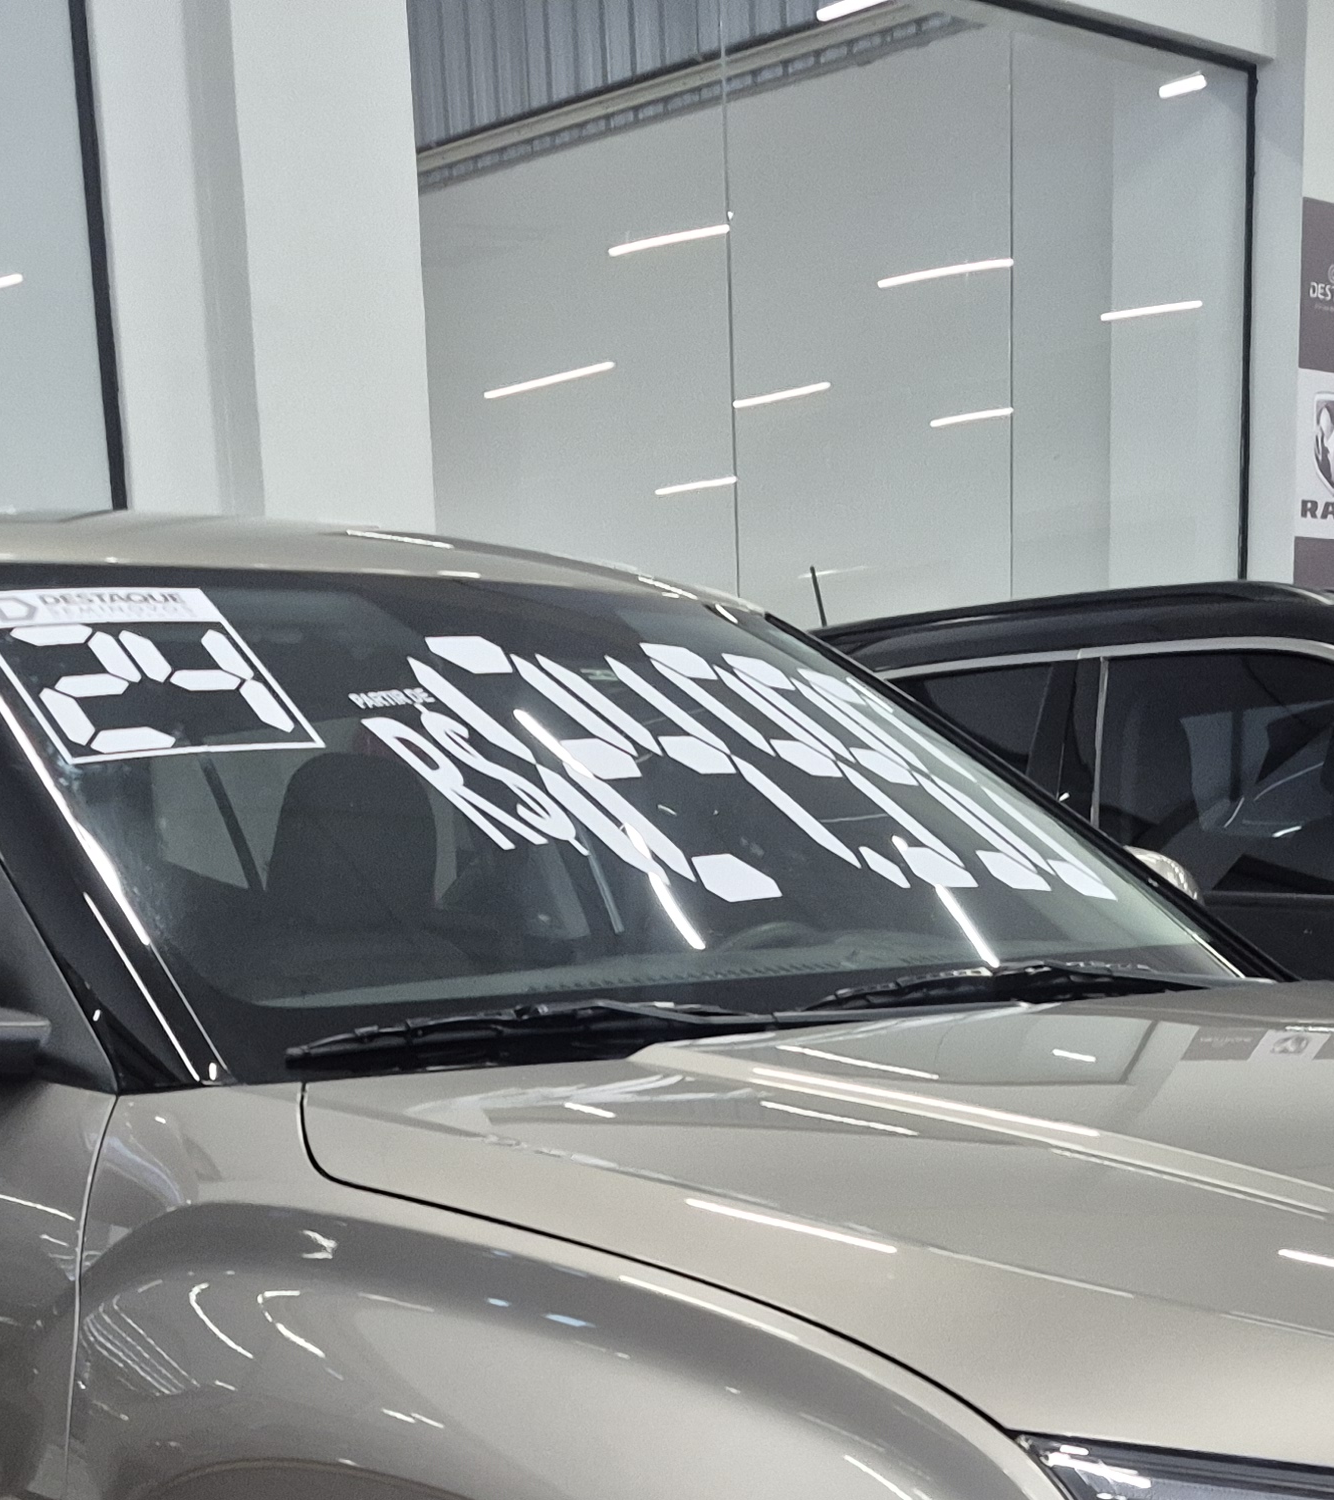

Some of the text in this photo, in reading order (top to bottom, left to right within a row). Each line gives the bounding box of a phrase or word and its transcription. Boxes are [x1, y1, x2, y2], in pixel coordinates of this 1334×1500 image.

[39, 591, 186, 606] DESTAQUE
[10, 624, 295, 754] 24
[348, 687, 436, 709] PARTIR DE
